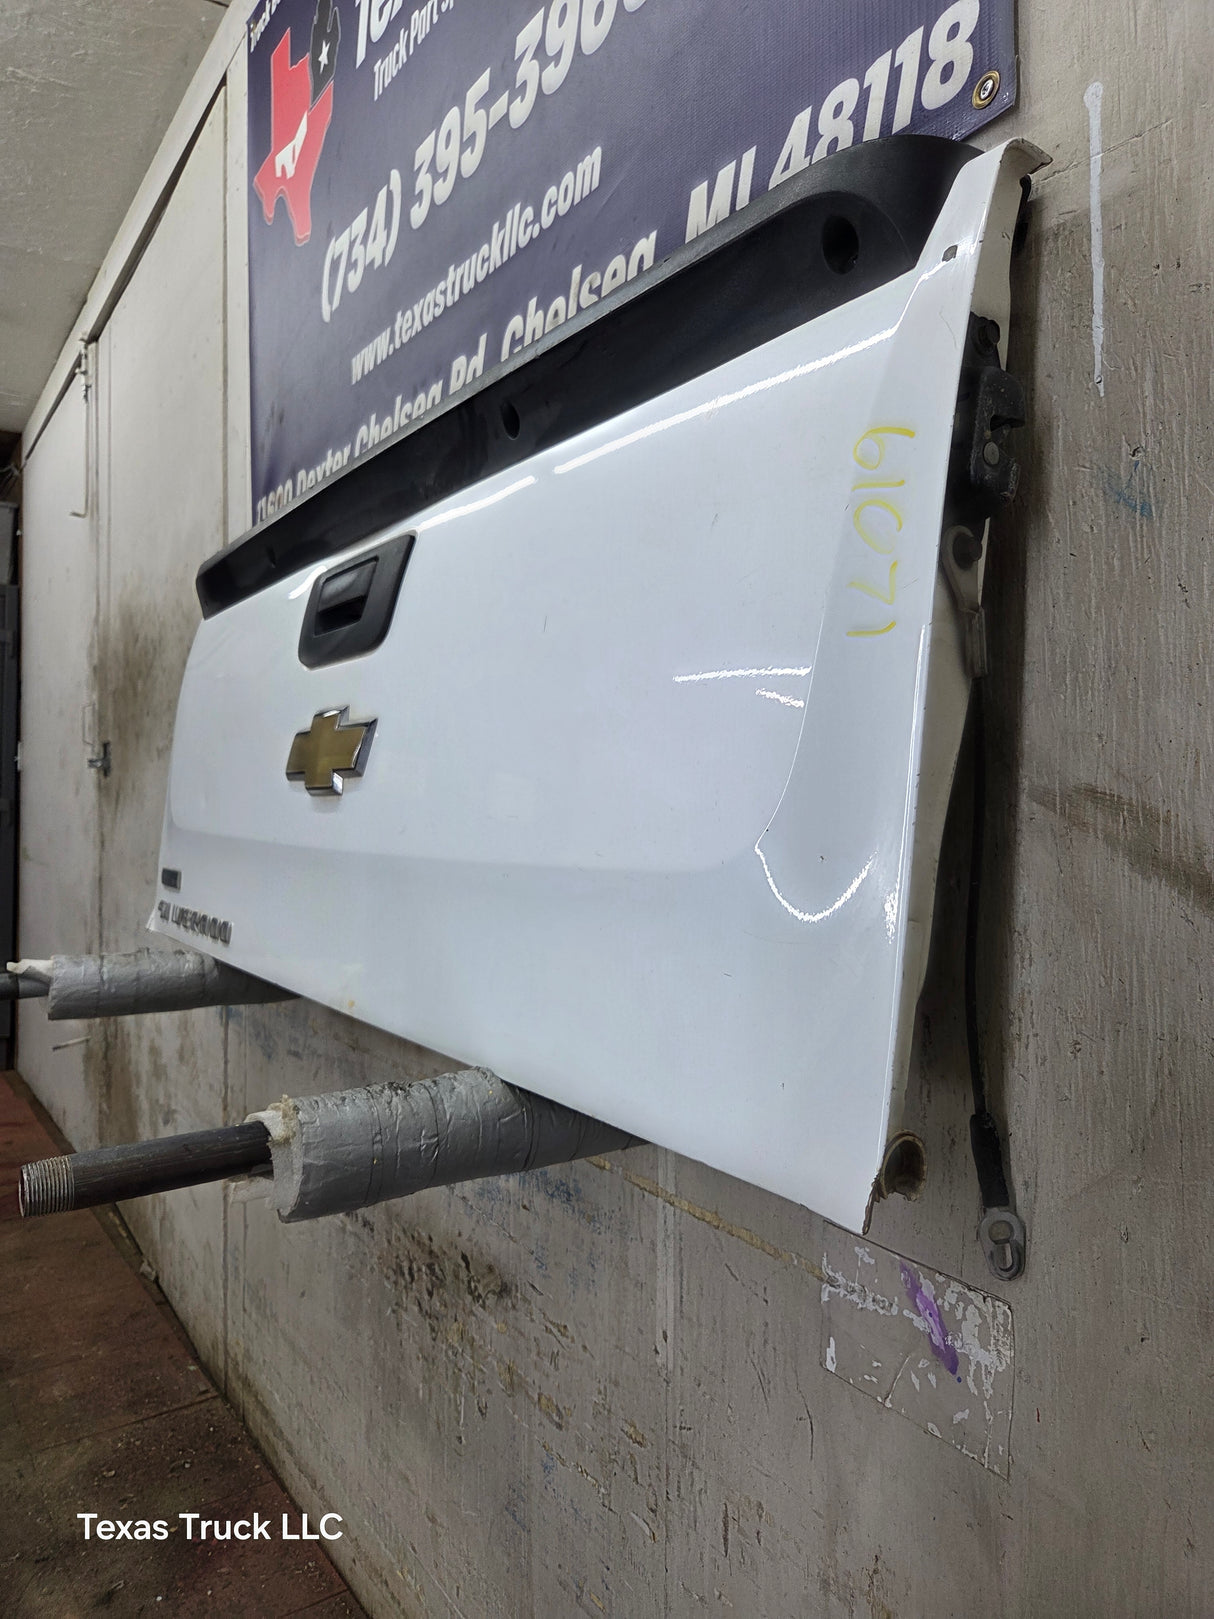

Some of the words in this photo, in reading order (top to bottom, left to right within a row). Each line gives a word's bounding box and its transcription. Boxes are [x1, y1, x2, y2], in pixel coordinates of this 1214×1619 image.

[321, 169, 401, 322] (734)
[410, 0, 647, 230] 395-39
[373, 28, 408, 102] Truck
[409, 0, 438, 56] Part
[684, 145, 756, 244] MI
[768, 0, 980, 191] 48118
[351, 146, 602, 385] www.texastruckllc.com
